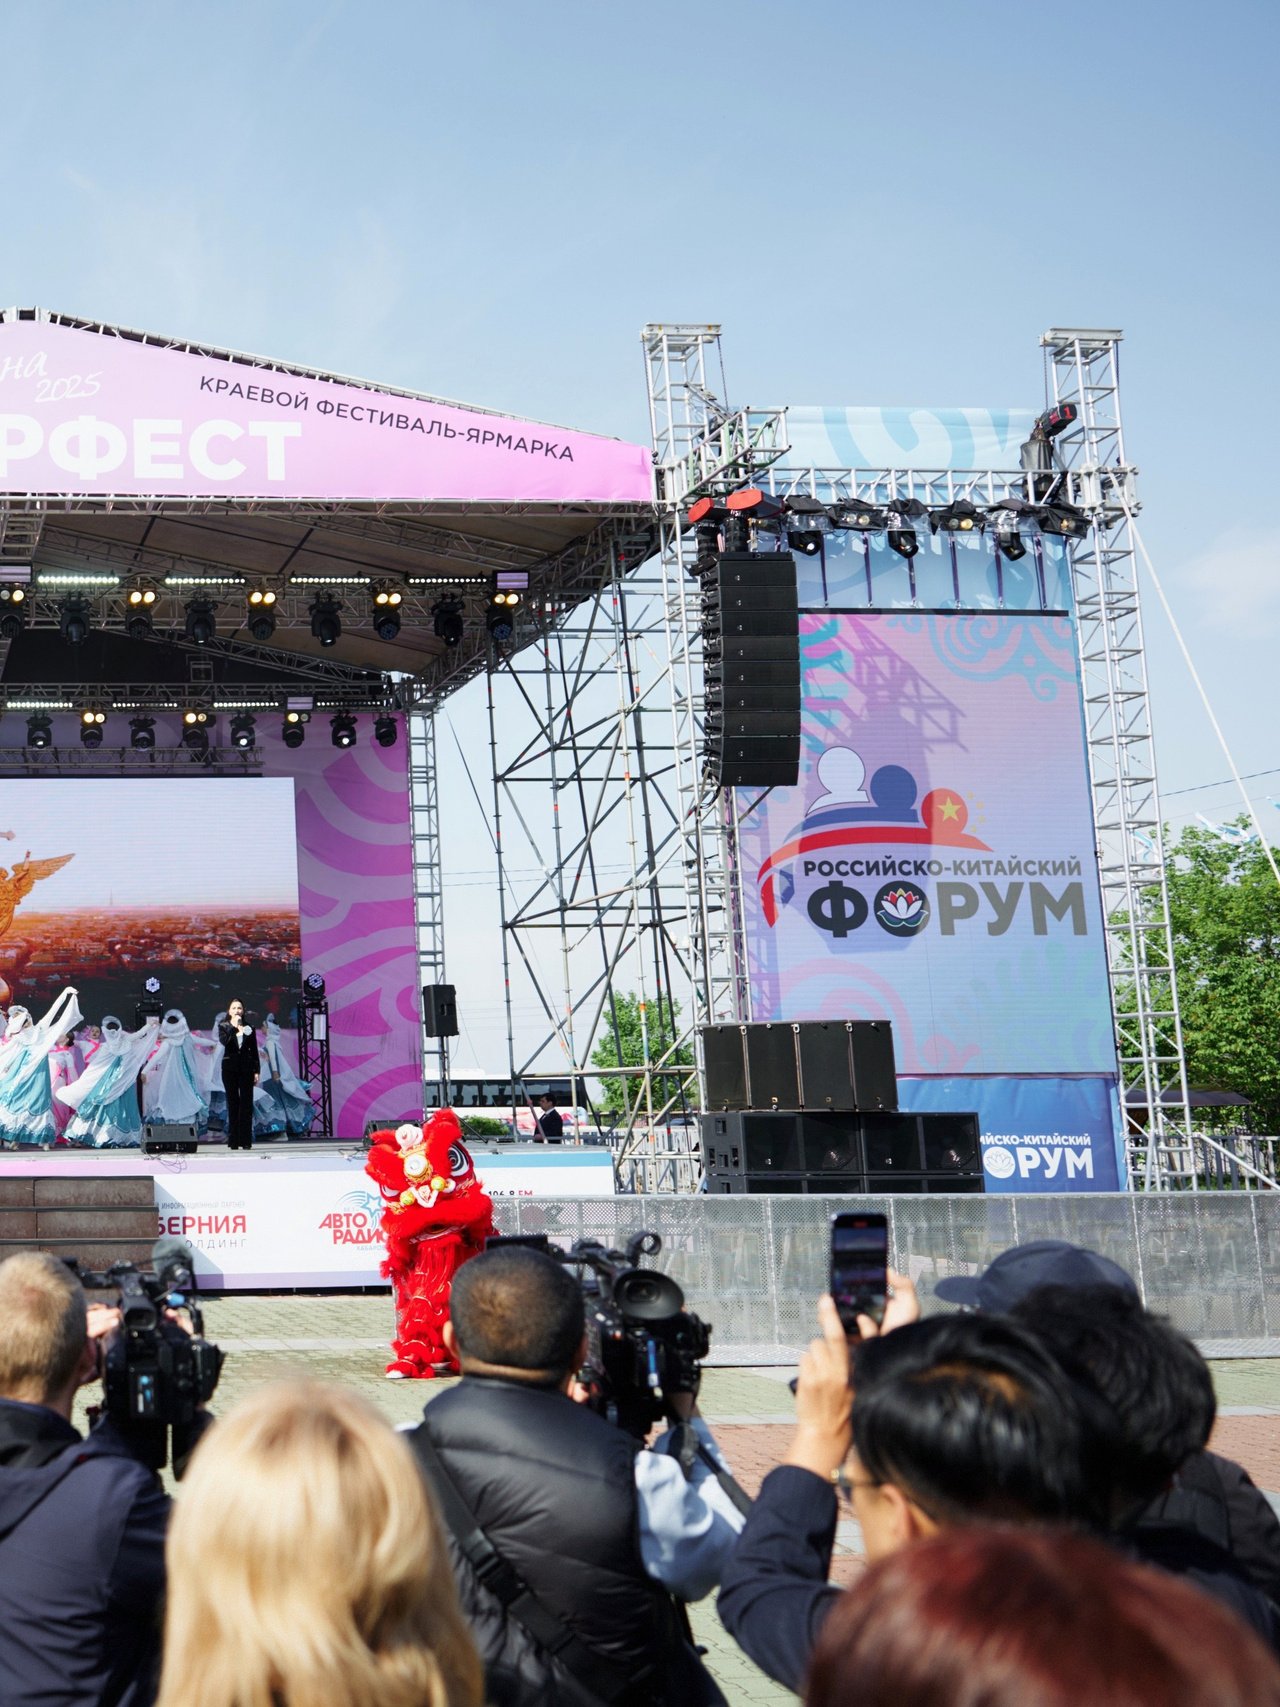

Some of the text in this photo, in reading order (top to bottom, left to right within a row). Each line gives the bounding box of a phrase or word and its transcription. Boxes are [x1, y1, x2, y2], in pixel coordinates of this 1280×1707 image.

[33, 371, 104, 403] 2025
[199, 374, 575, 463] КРАЕВОЙ ФЕСТИВАЛЬ-ЯРМАРКА
[803, 854, 1083, 877] РОССИЙСКО-КИТАЙСКИЙ
[806, 879, 1089, 939] ФОРУМ
[983, 1146, 1094, 1179] ОРУМ
[318, 1212, 368, 1229] АВТО
